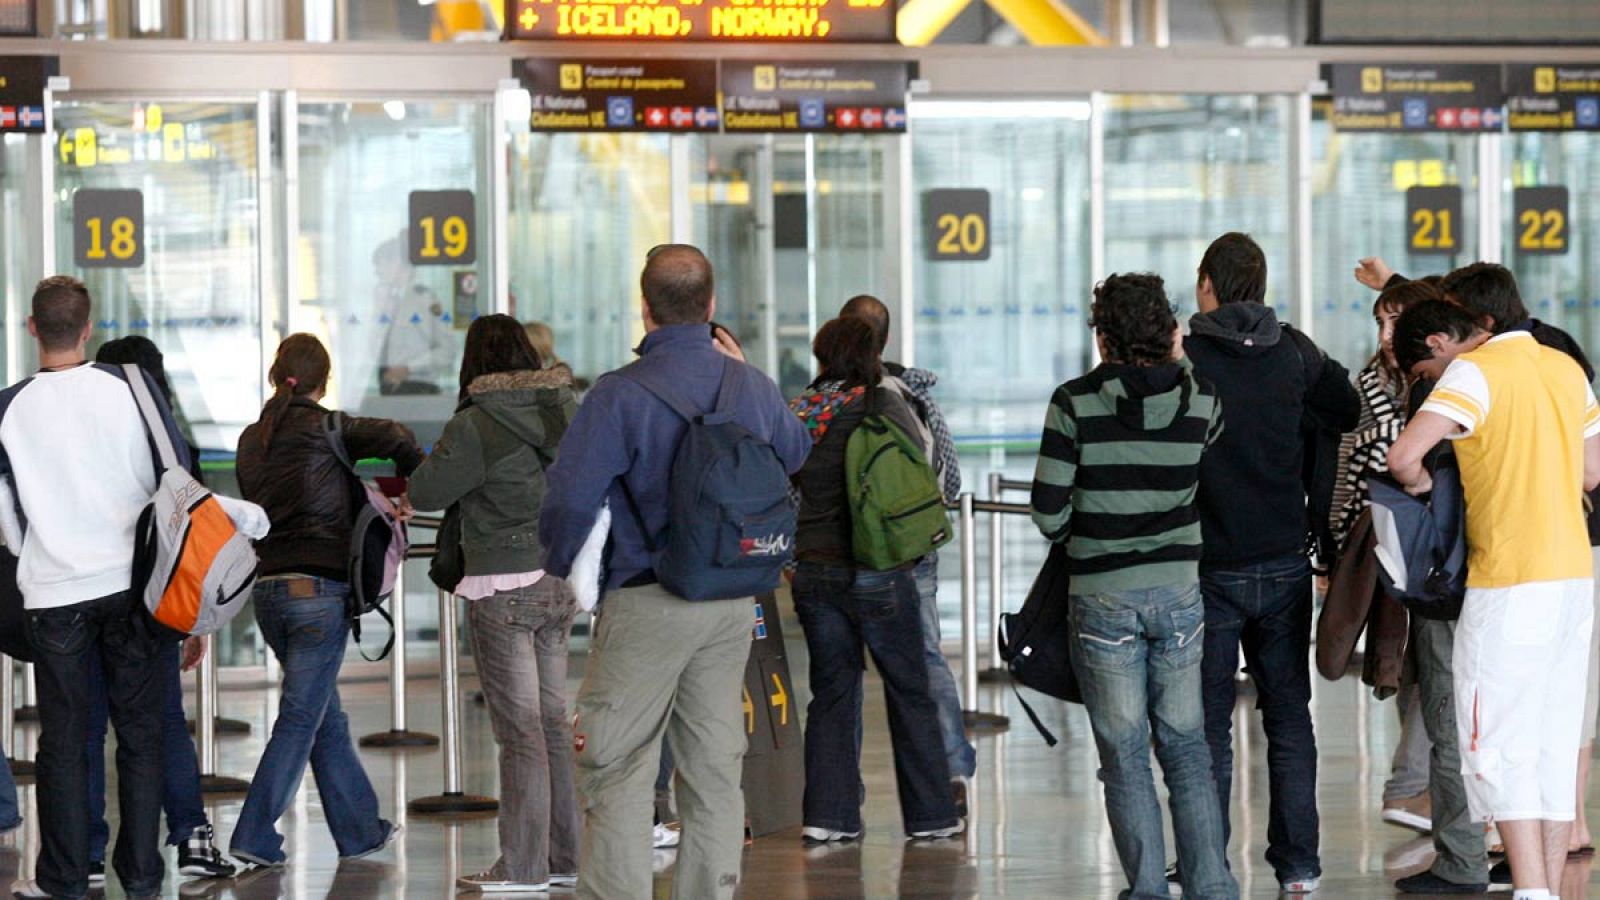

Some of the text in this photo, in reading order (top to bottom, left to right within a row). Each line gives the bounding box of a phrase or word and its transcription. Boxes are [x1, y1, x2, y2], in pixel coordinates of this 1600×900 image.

[557, 5, 692, 36] ICELAND,
[711, 6, 830, 37] NORWAY,
[86, 216, 137, 259] 18
[420, 215, 468, 257] 19
[937, 213, 986, 254] 20
[1411, 208, 1455, 249] 21
[1519, 208, 1565, 249] 22
